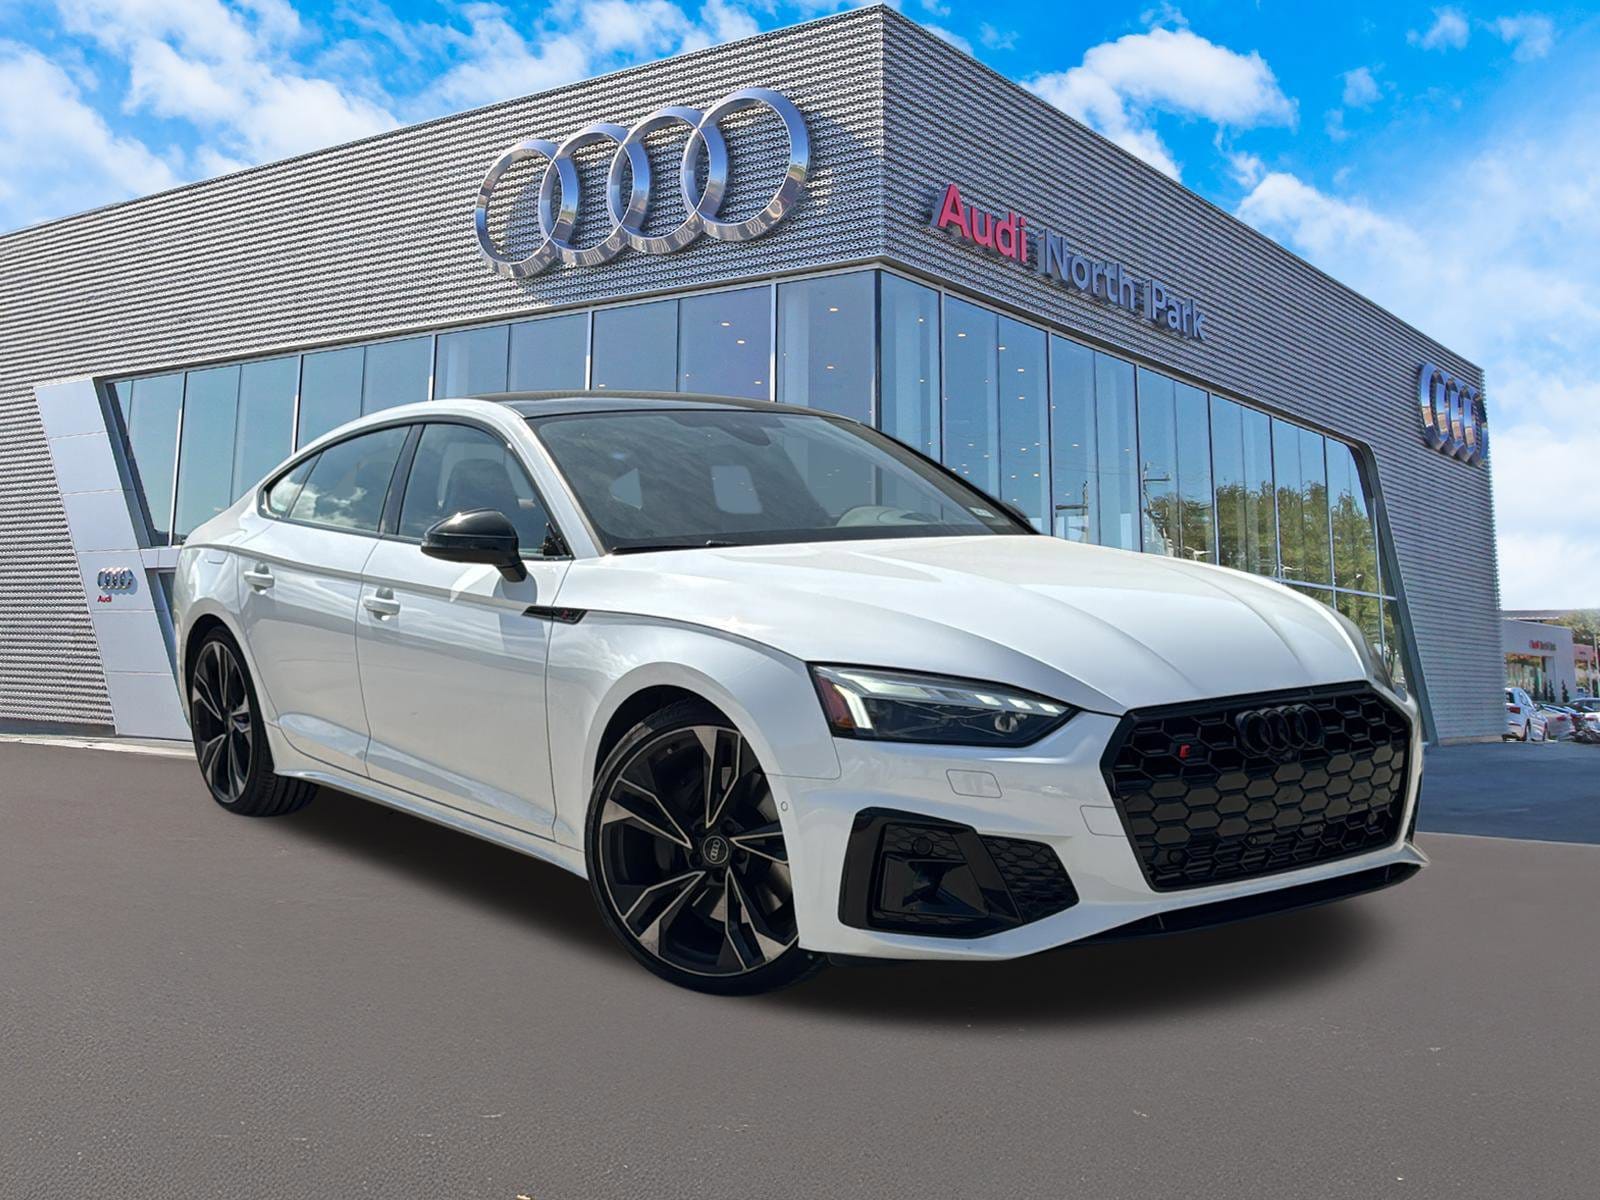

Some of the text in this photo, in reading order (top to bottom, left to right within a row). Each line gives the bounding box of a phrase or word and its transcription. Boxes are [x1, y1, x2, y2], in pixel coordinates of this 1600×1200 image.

[934, 183, 1207, 341] Audi North Park
[97, 595, 112, 603] Audi
